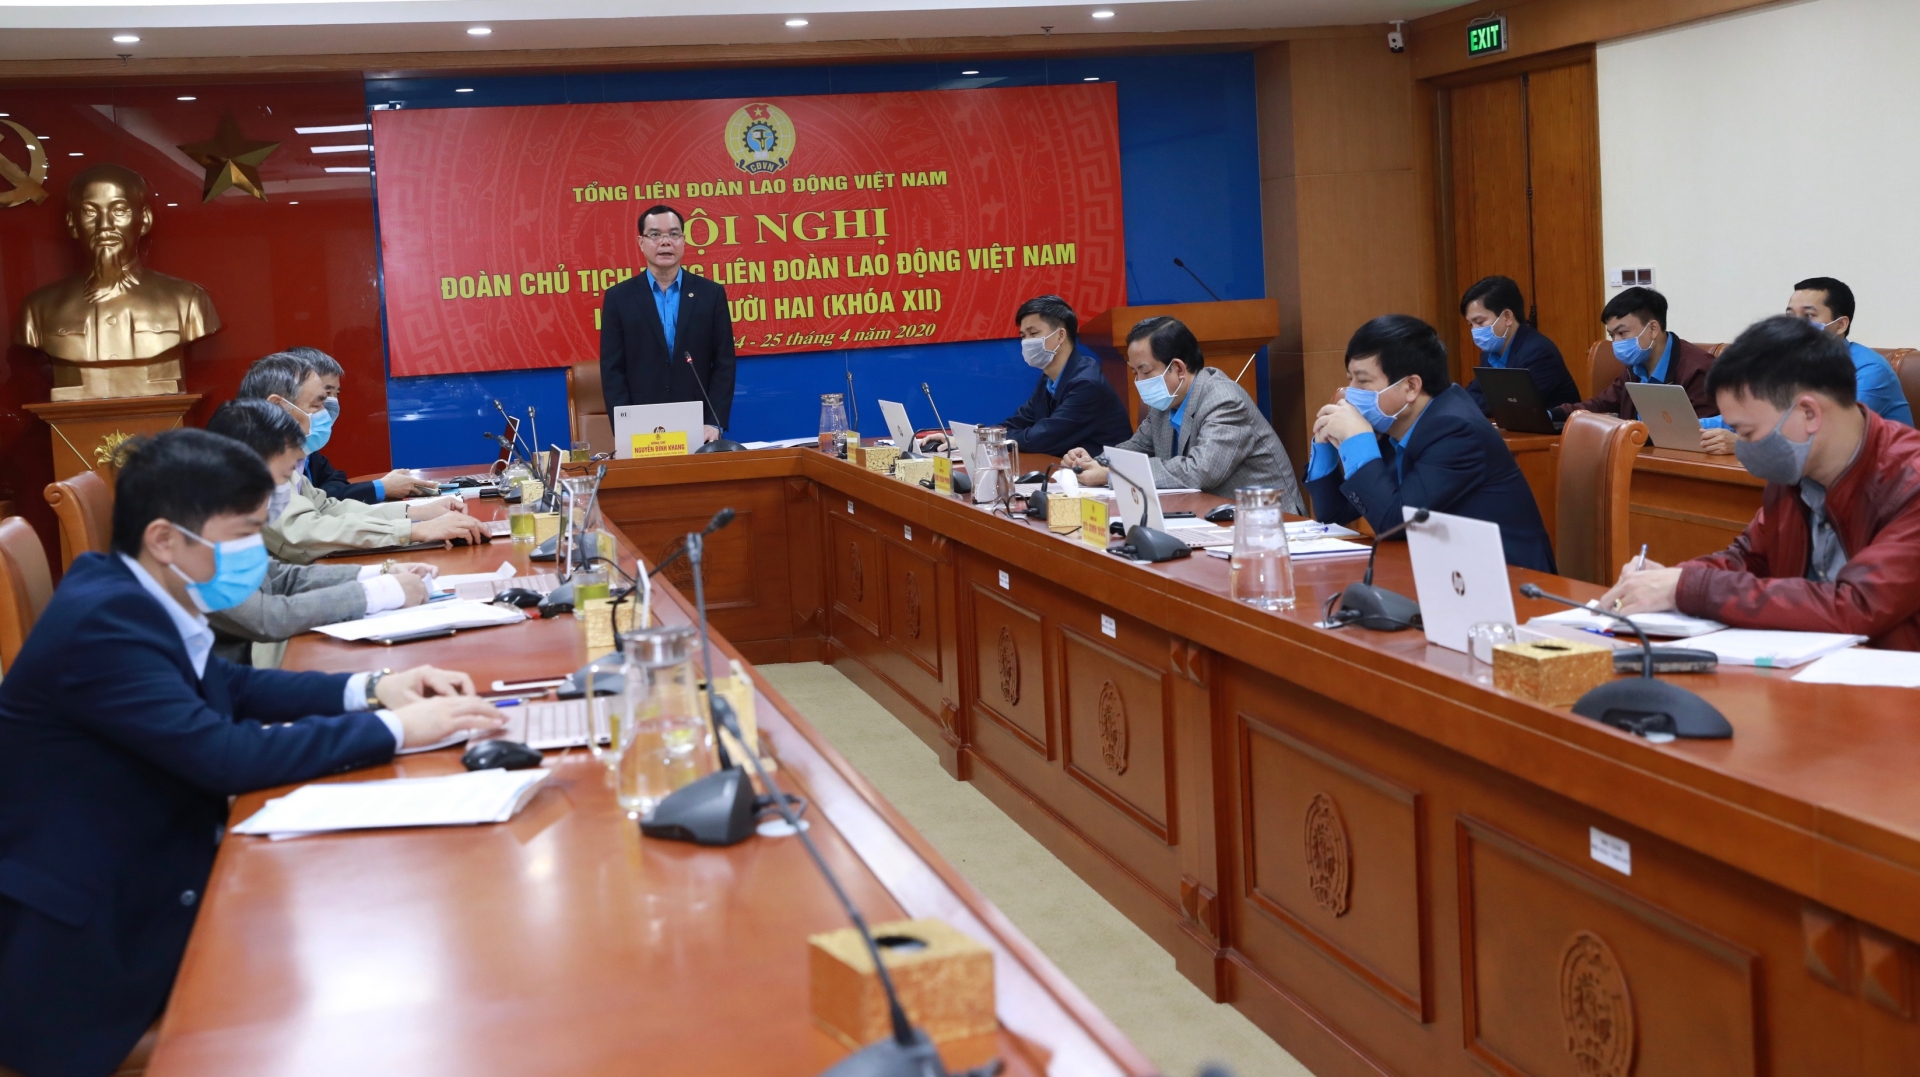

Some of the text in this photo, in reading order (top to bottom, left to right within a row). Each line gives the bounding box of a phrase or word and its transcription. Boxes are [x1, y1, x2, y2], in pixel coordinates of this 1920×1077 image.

[1470, 24, 1499, 51] EXIT
[573, 171, 947, 203] TỔNG LIÊN ĐOÀN LAO ĐỘNG VIỆT NAM
[684, 207, 890, 255] ỘI NGHỊ
[712, 257, 766, 285] LIÊN
[772, 253, 839, 282] ĐOÀN
[846, 253, 890, 277] LAO
[896, 247, 961, 278] ĐỘNG
[967, 242, 1016, 274] VIỆT
[1022, 243, 1076, 267] NAM
[441, 270, 511, 299] ĐOÀN
[519, 263, 570, 296] CHỦ
[577, 267, 632, 296] TỊCH
[728, 288, 942, 322] ƯỜI HAI (KHÓA XII)
[734, 332, 746, 349] 4
[760, 332, 784, 347] 25
[785, 331, 835, 346] tháng
[839, 329, 851, 341] 4
[853, 326, 891, 342] năm
[895, 323, 937, 339] 2020
